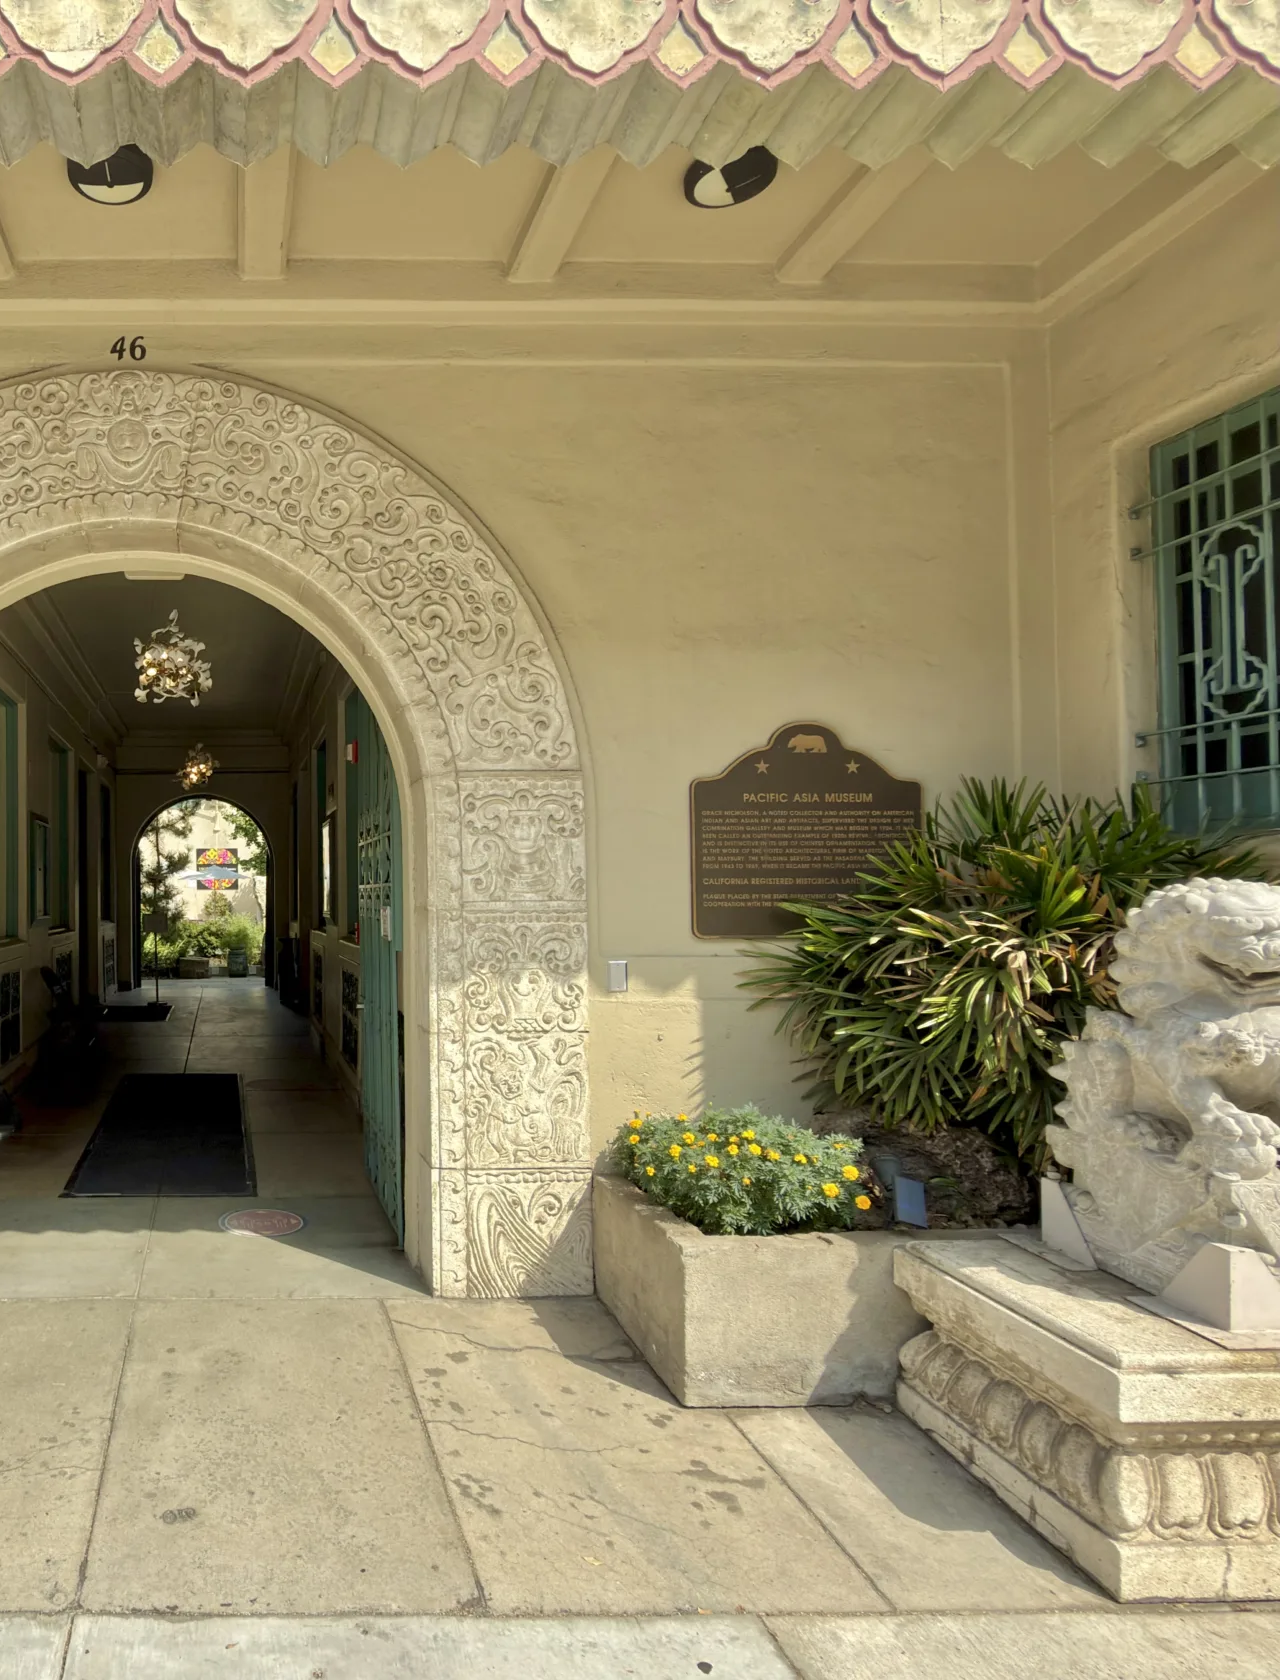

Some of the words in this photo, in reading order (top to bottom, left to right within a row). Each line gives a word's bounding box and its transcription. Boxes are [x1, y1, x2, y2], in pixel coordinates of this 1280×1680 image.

[110, 336, 146, 361] 46
[743, 793, 788, 803] PACIFIC
[793, 793, 820, 803] ASIA
[825, 793, 873, 803] MUSEUM
